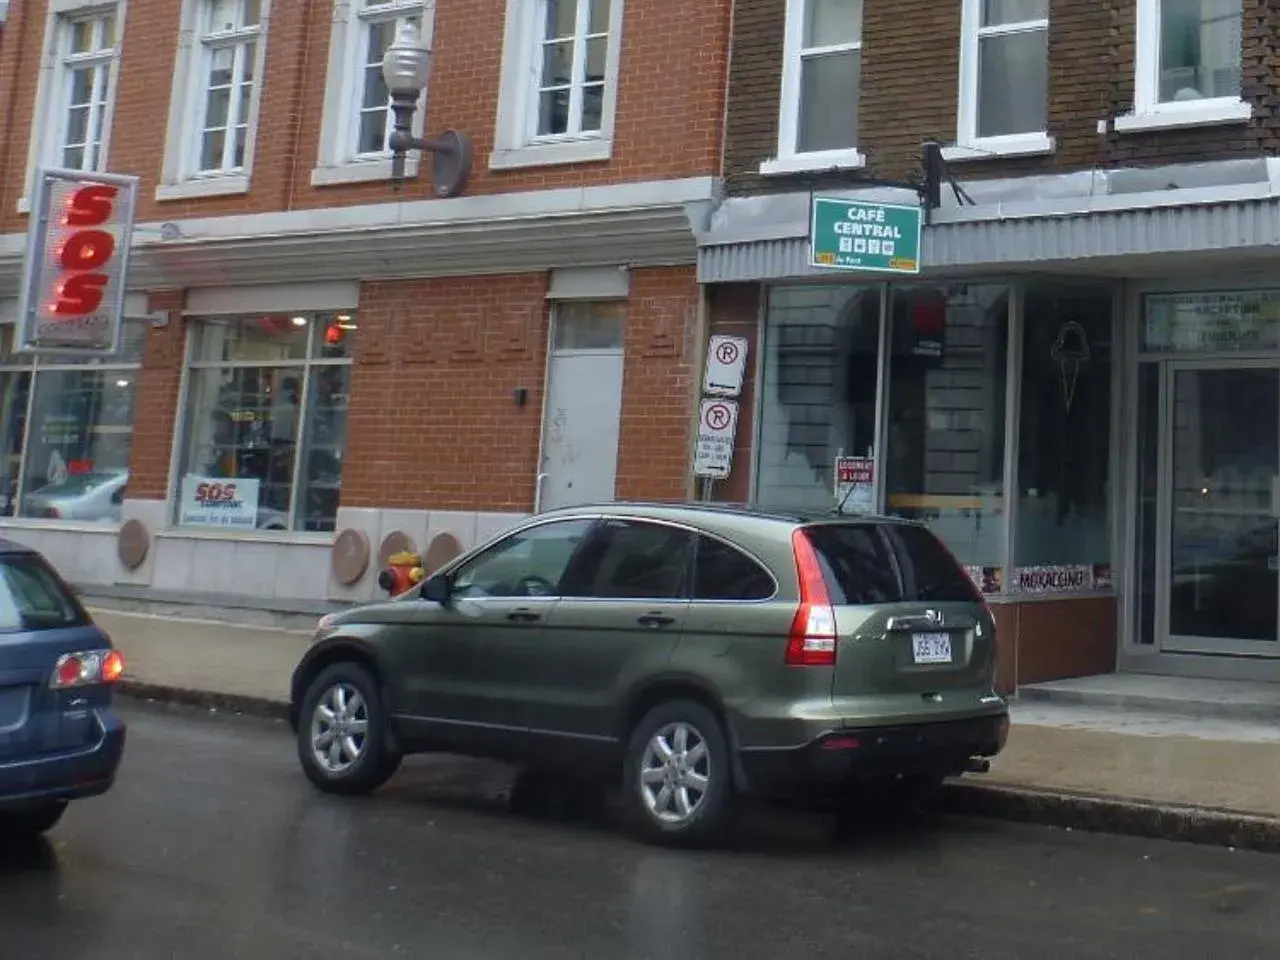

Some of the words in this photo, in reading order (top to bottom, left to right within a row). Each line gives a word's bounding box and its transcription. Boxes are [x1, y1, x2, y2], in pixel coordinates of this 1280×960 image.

[847, 204, 886, 223] CAFÉ
[833, 220, 903, 239] CENTRAL
[194, 483, 237, 502] SOS
